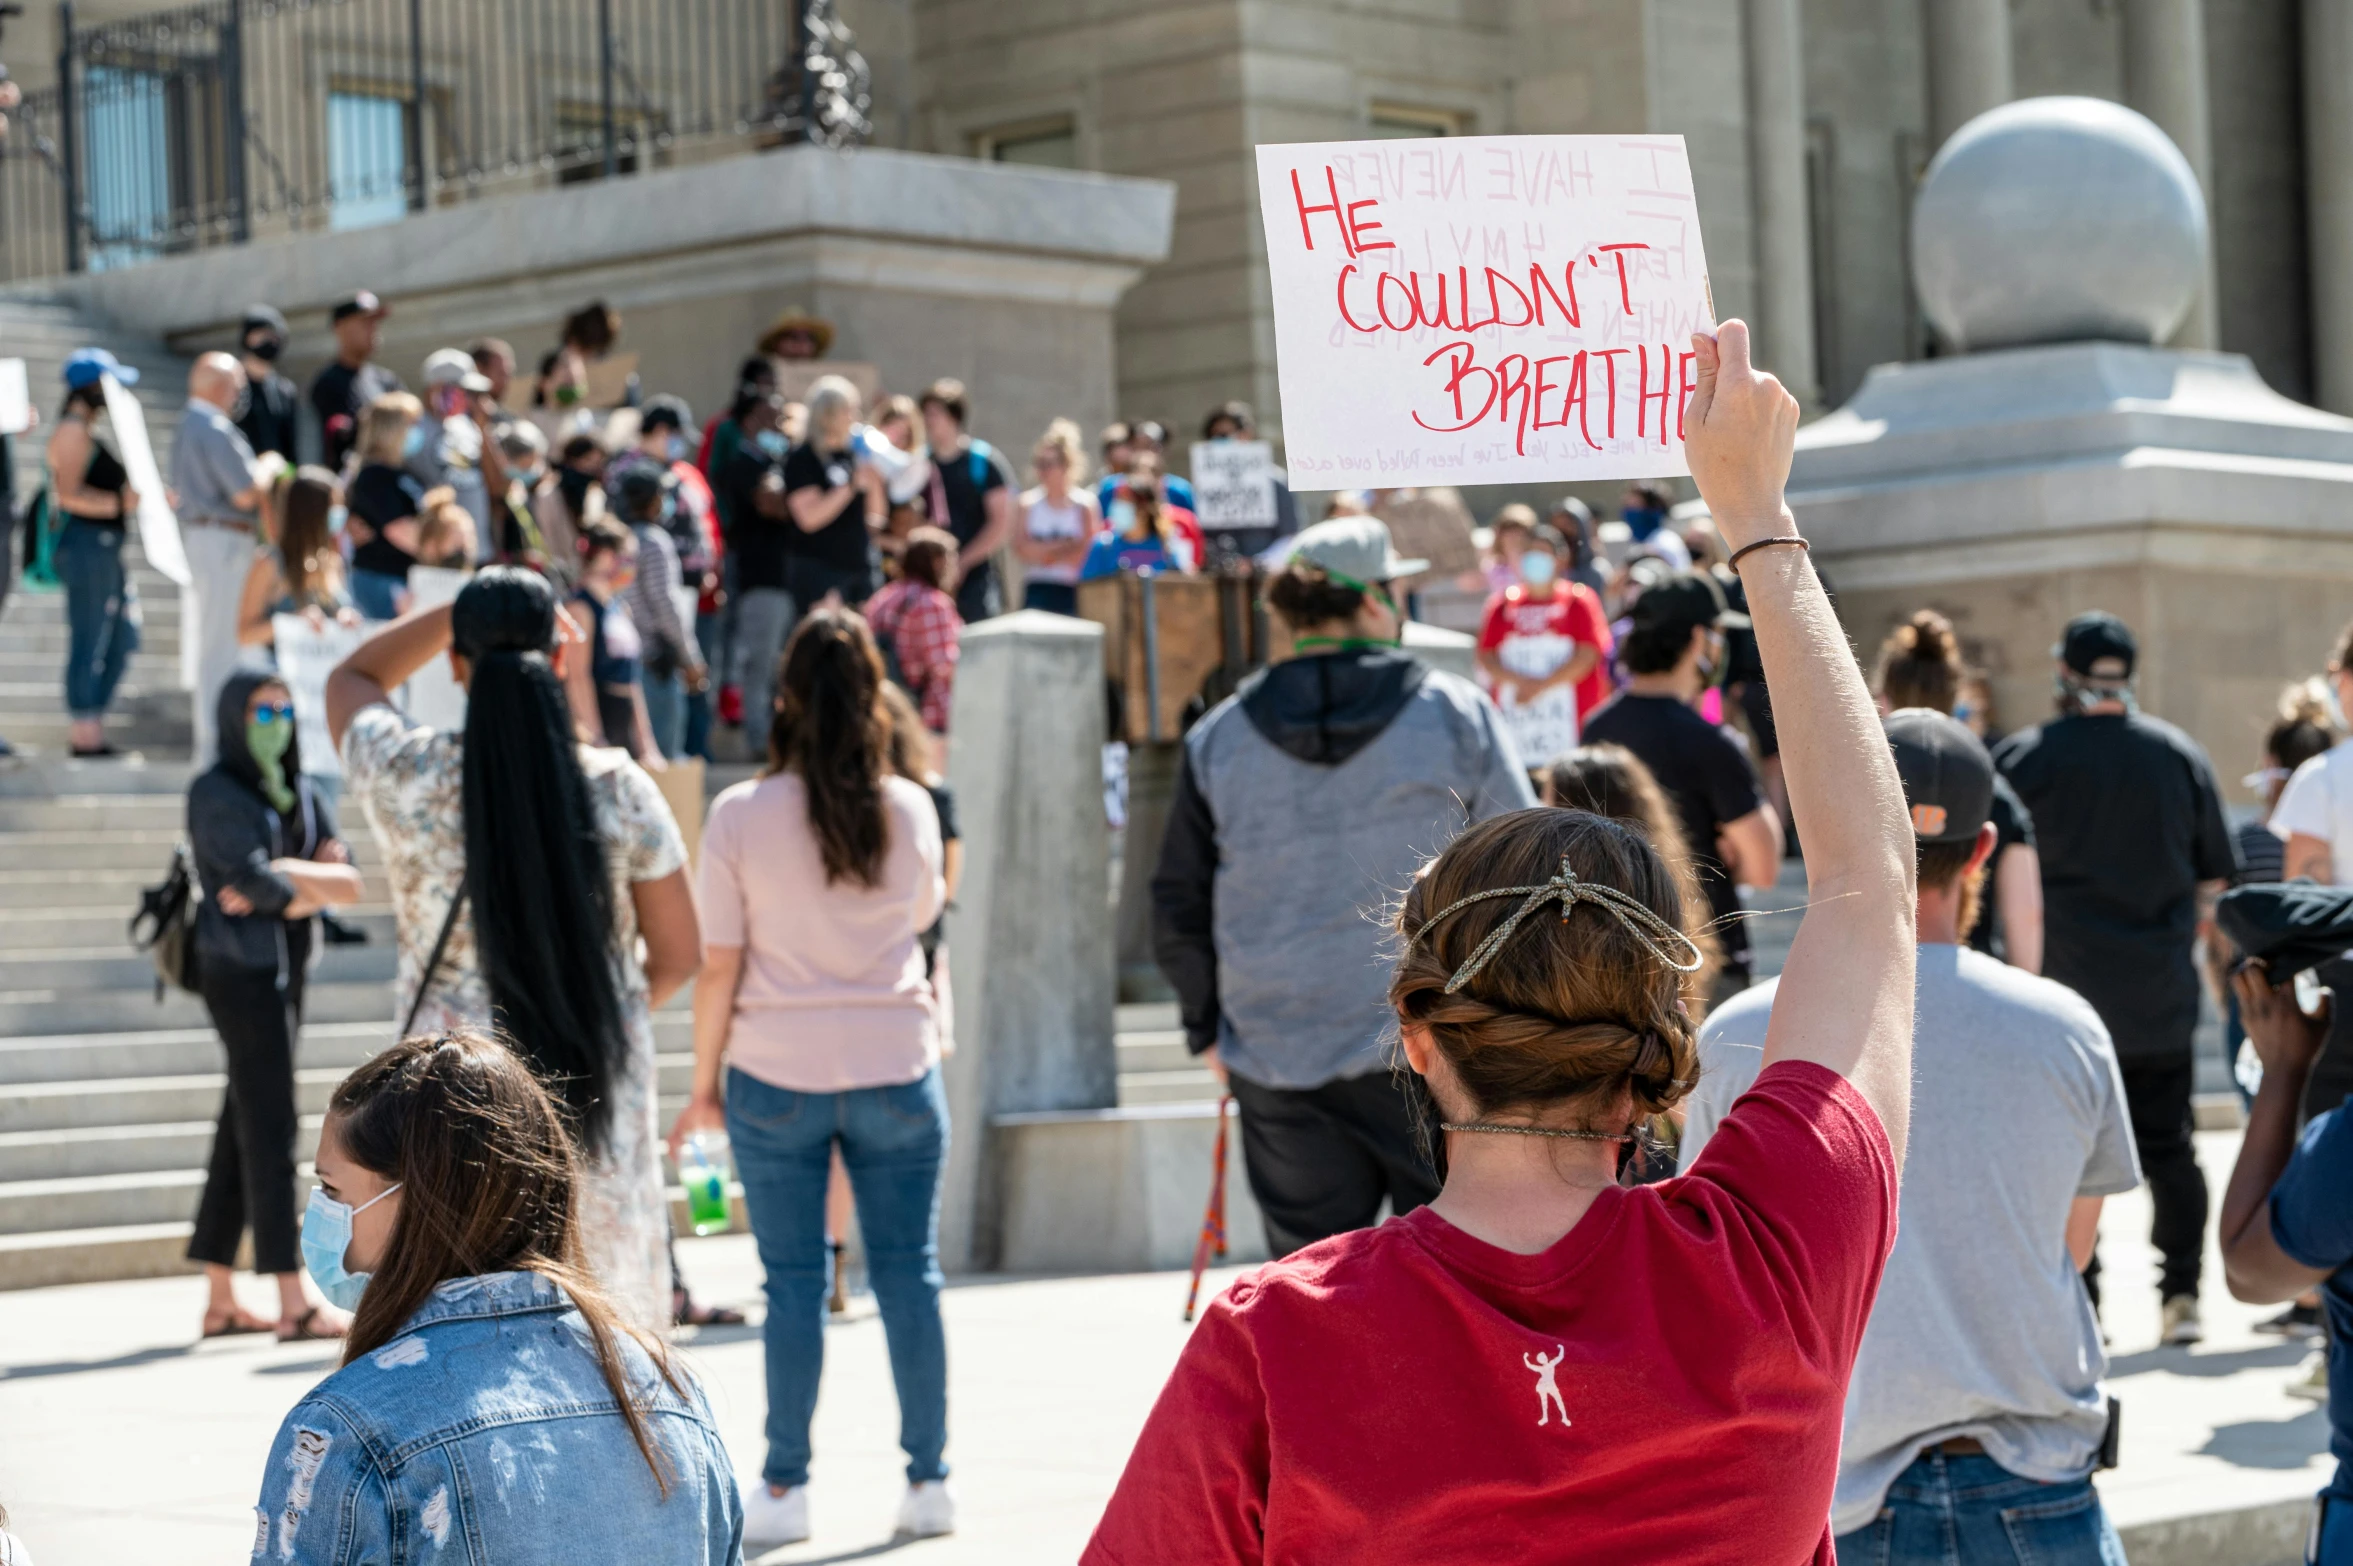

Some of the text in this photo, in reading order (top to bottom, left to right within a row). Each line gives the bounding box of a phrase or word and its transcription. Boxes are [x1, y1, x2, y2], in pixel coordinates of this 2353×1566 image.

[1291, 166, 1397, 260] HE
[1337, 243, 1651, 334] COULDN'T
[1412, 342, 1696, 456] BREATHE
